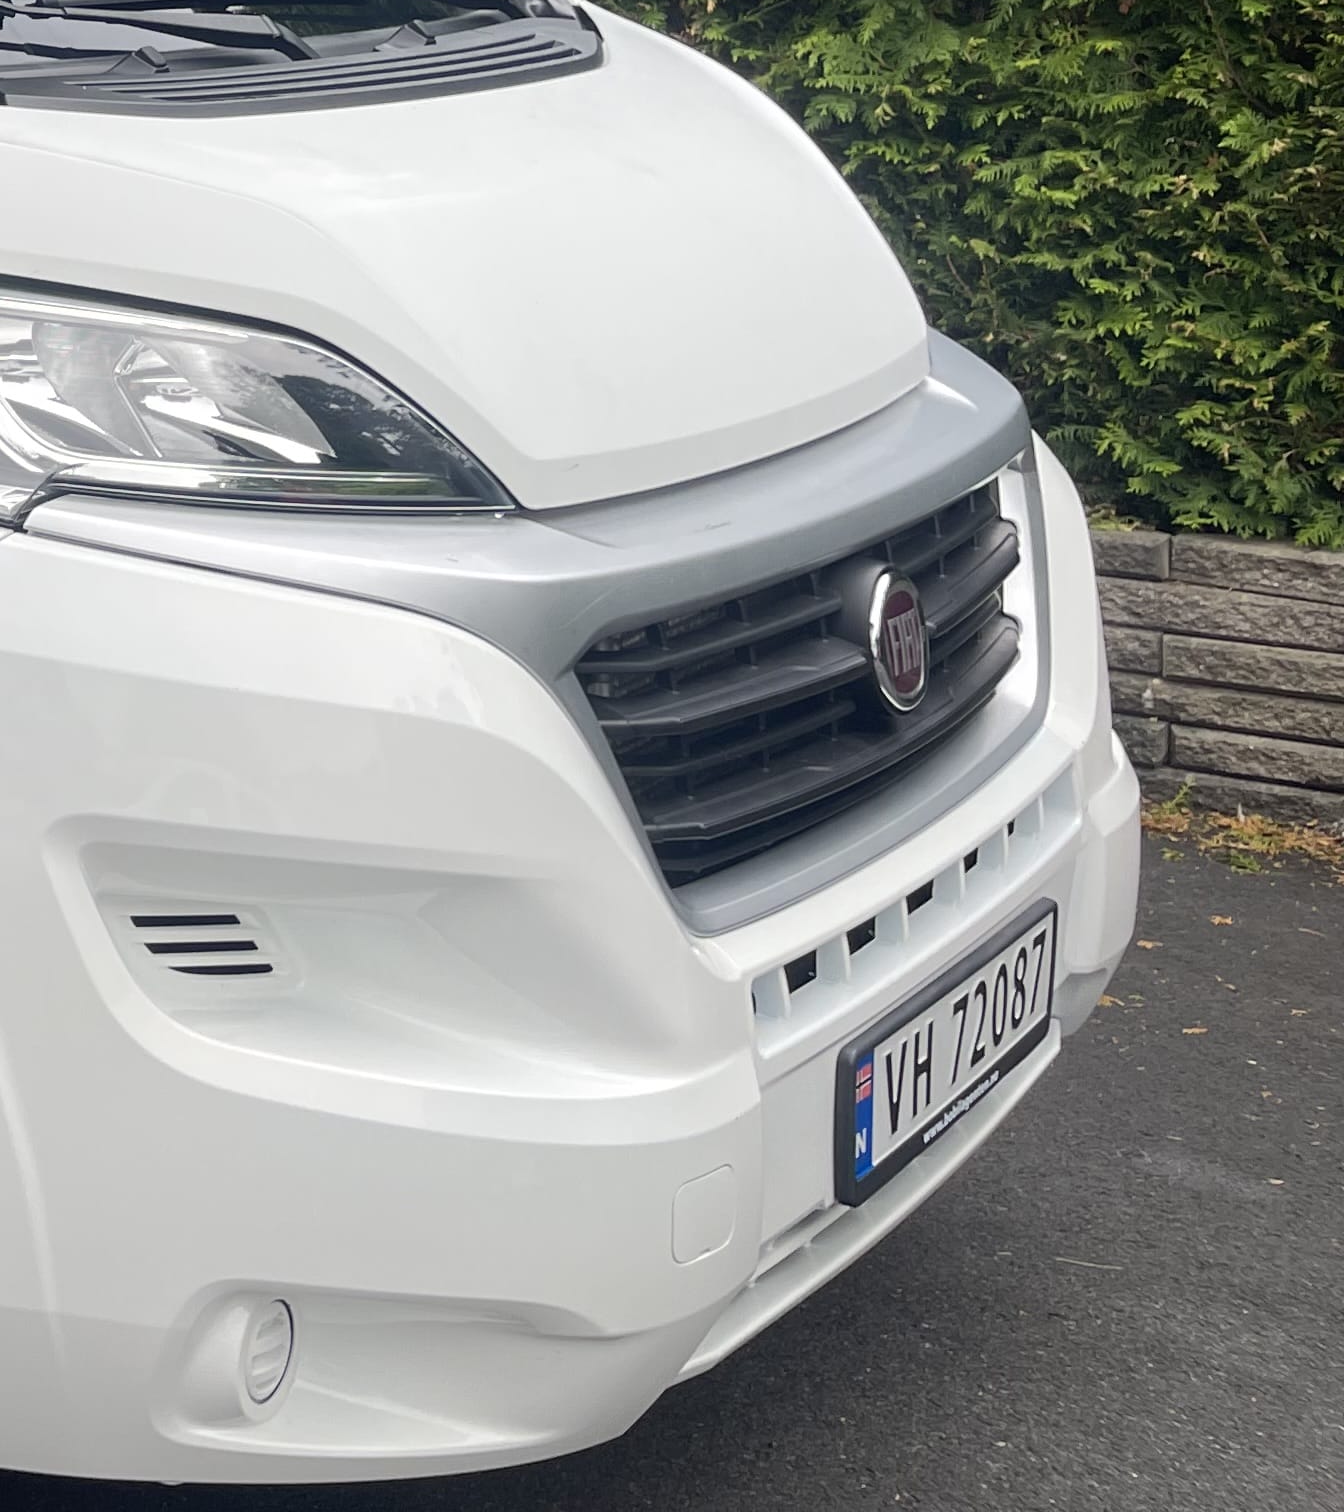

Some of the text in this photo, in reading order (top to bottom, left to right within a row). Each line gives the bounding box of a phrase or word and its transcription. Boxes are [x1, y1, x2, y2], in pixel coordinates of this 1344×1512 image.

[885, 928, 1047, 1136] VH 72087
[855, 1127, 868, 1160] N
